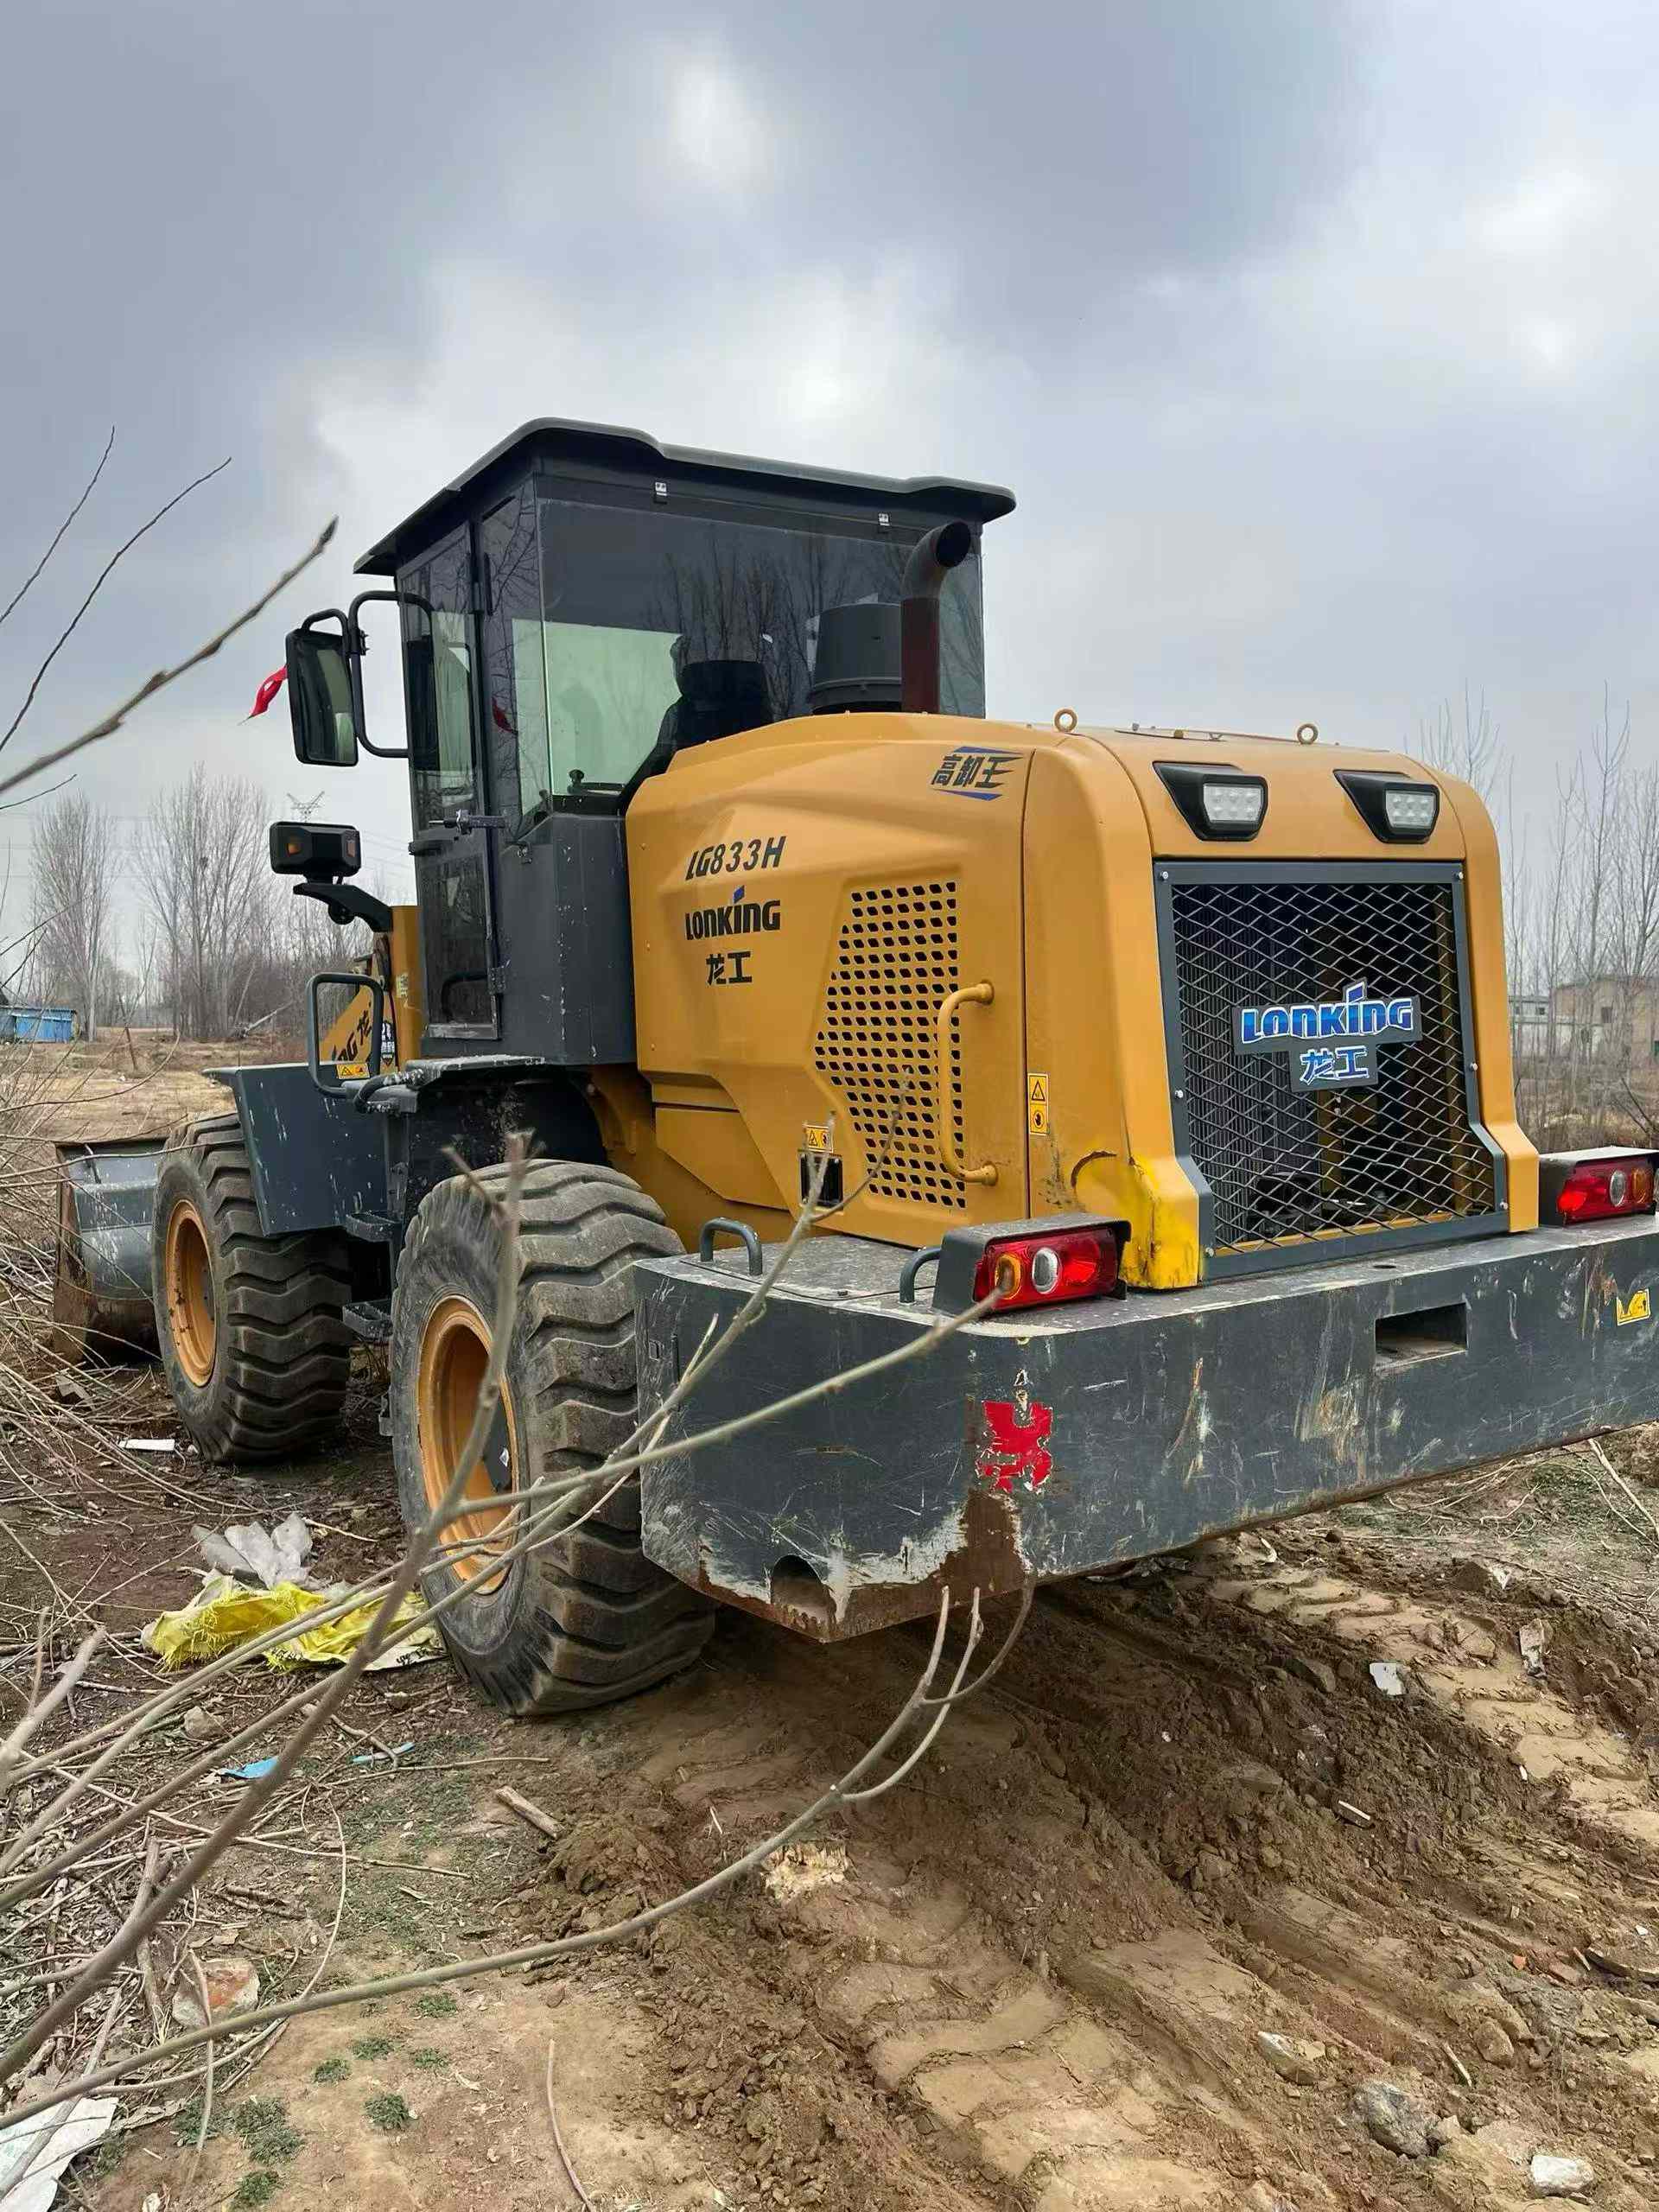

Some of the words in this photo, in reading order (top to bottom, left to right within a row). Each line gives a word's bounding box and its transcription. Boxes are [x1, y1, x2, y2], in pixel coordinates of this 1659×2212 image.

[685, 836, 786, 880] LG833H
[705, 950, 753, 986] 龙工
[1300, 1045, 1370, 1085] 龙工
